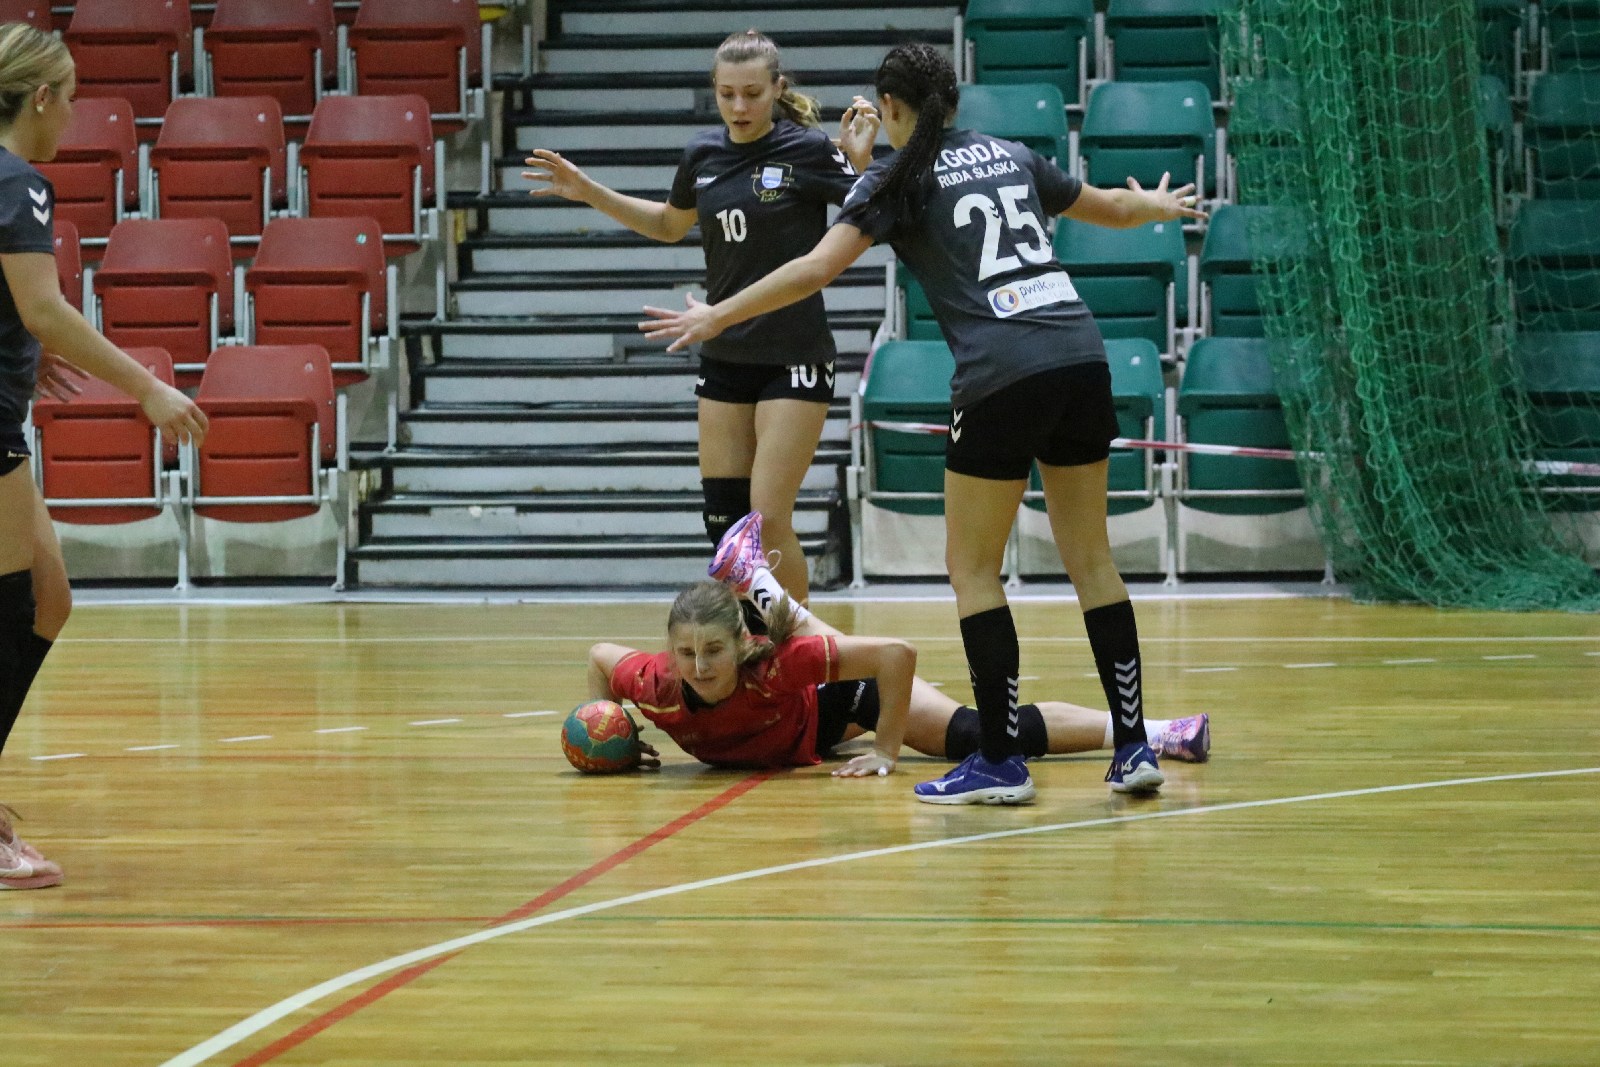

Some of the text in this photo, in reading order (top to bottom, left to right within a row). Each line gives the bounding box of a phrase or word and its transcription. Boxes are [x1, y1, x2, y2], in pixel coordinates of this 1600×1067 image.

[937, 160, 1020, 189] RUDA ŚLĄSKA
[715, 208, 748, 242] 10
[953, 184, 1053, 282] 25
[1019, 280, 1050, 298] pwik
[786, 364, 818, 389] 10
